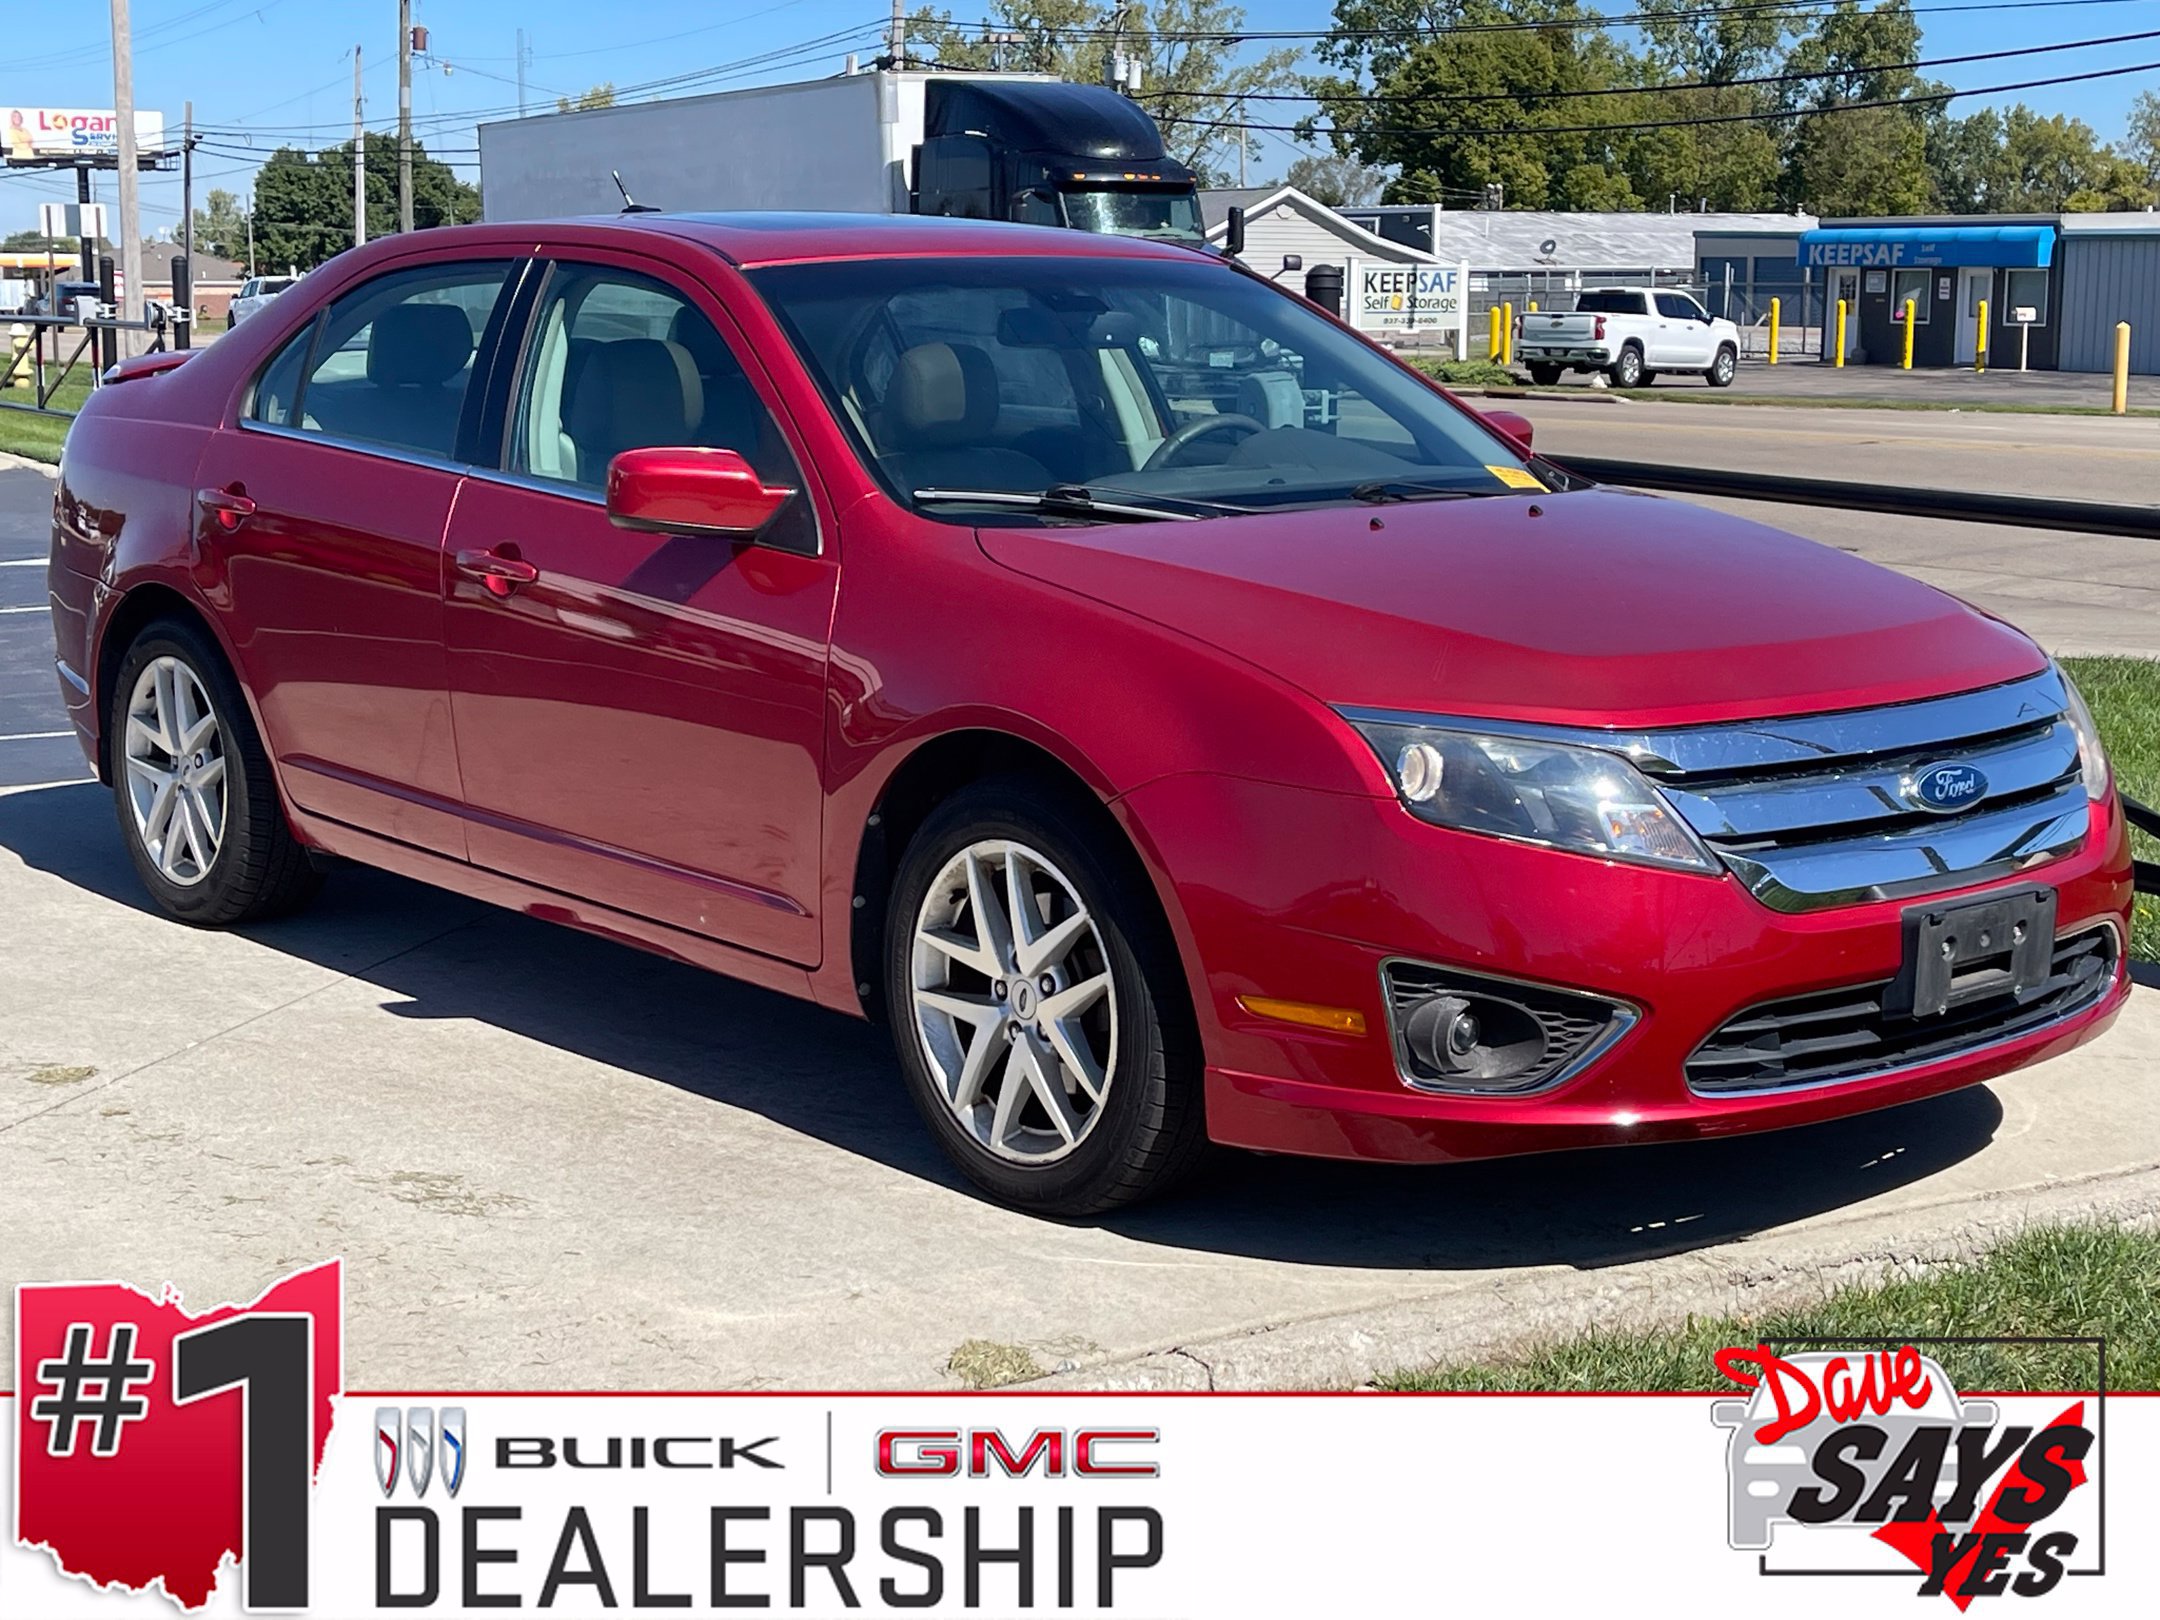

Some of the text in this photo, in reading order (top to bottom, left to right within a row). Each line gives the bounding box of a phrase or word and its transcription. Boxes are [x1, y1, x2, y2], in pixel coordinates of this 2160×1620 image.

[1808, 243, 1905, 265] KEEPSAF
[1365, 272, 1457, 293] KEEPSAF
[1365, 295, 1457, 312] Self Storage
[1935, 769, 1975, 800] Ford
